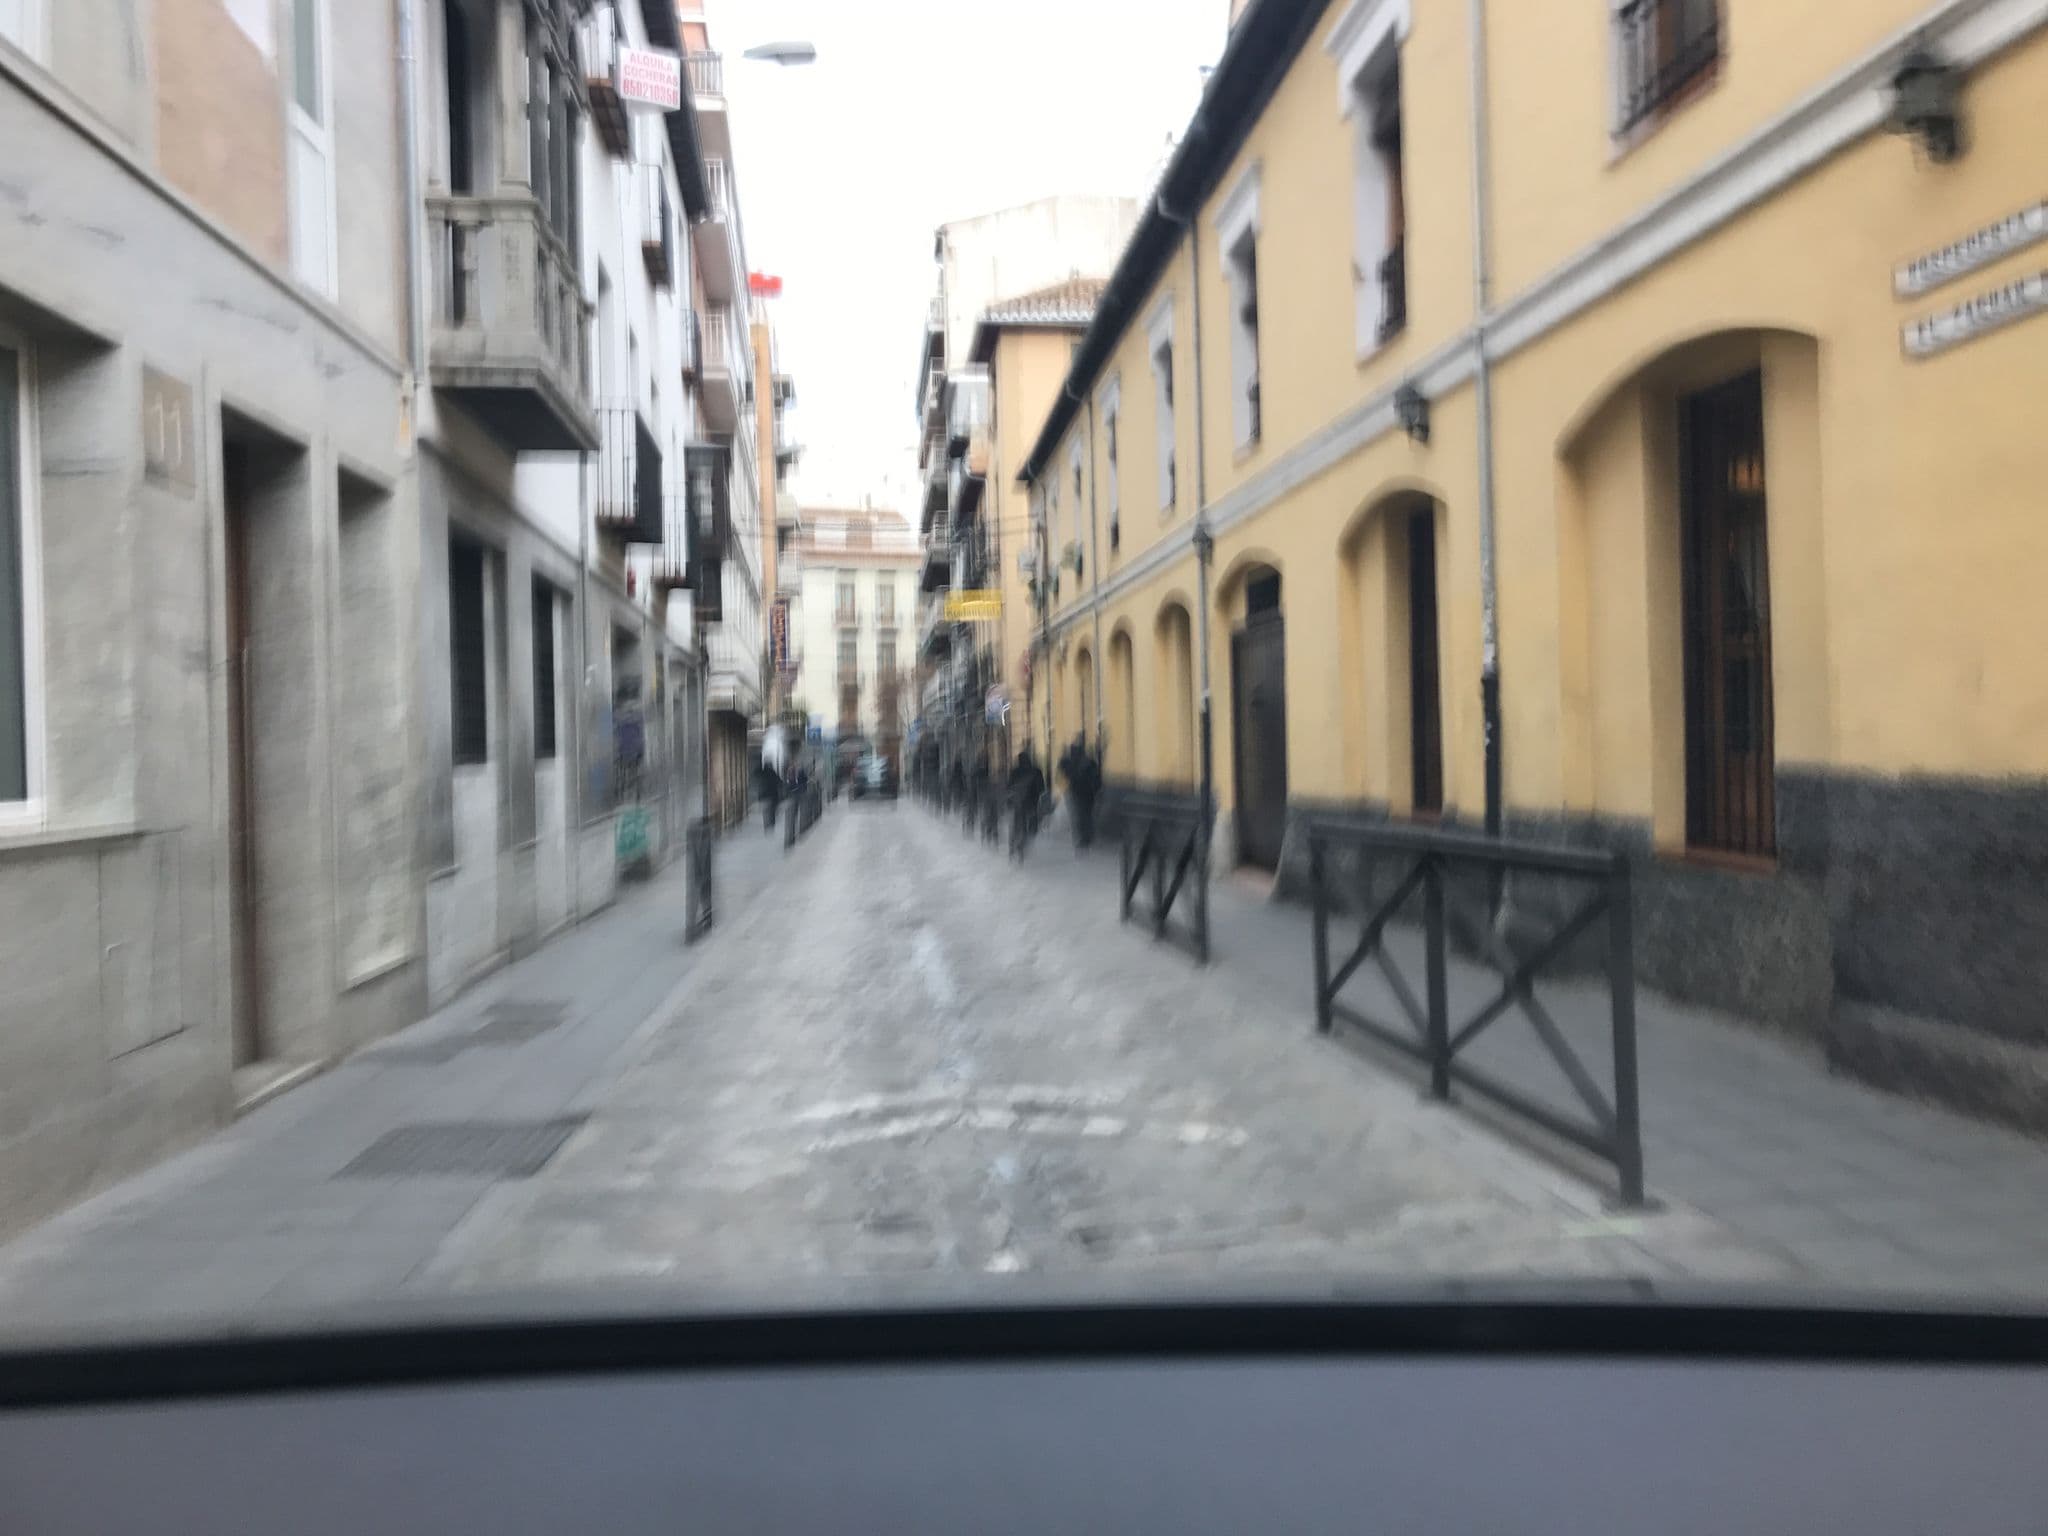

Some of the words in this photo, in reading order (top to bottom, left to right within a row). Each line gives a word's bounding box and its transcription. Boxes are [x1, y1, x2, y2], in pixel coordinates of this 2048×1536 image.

[630, 53, 673, 72] ALQUILA
[624, 64, 678, 87] COCHERAS
[150, 391, 182, 463] 11
